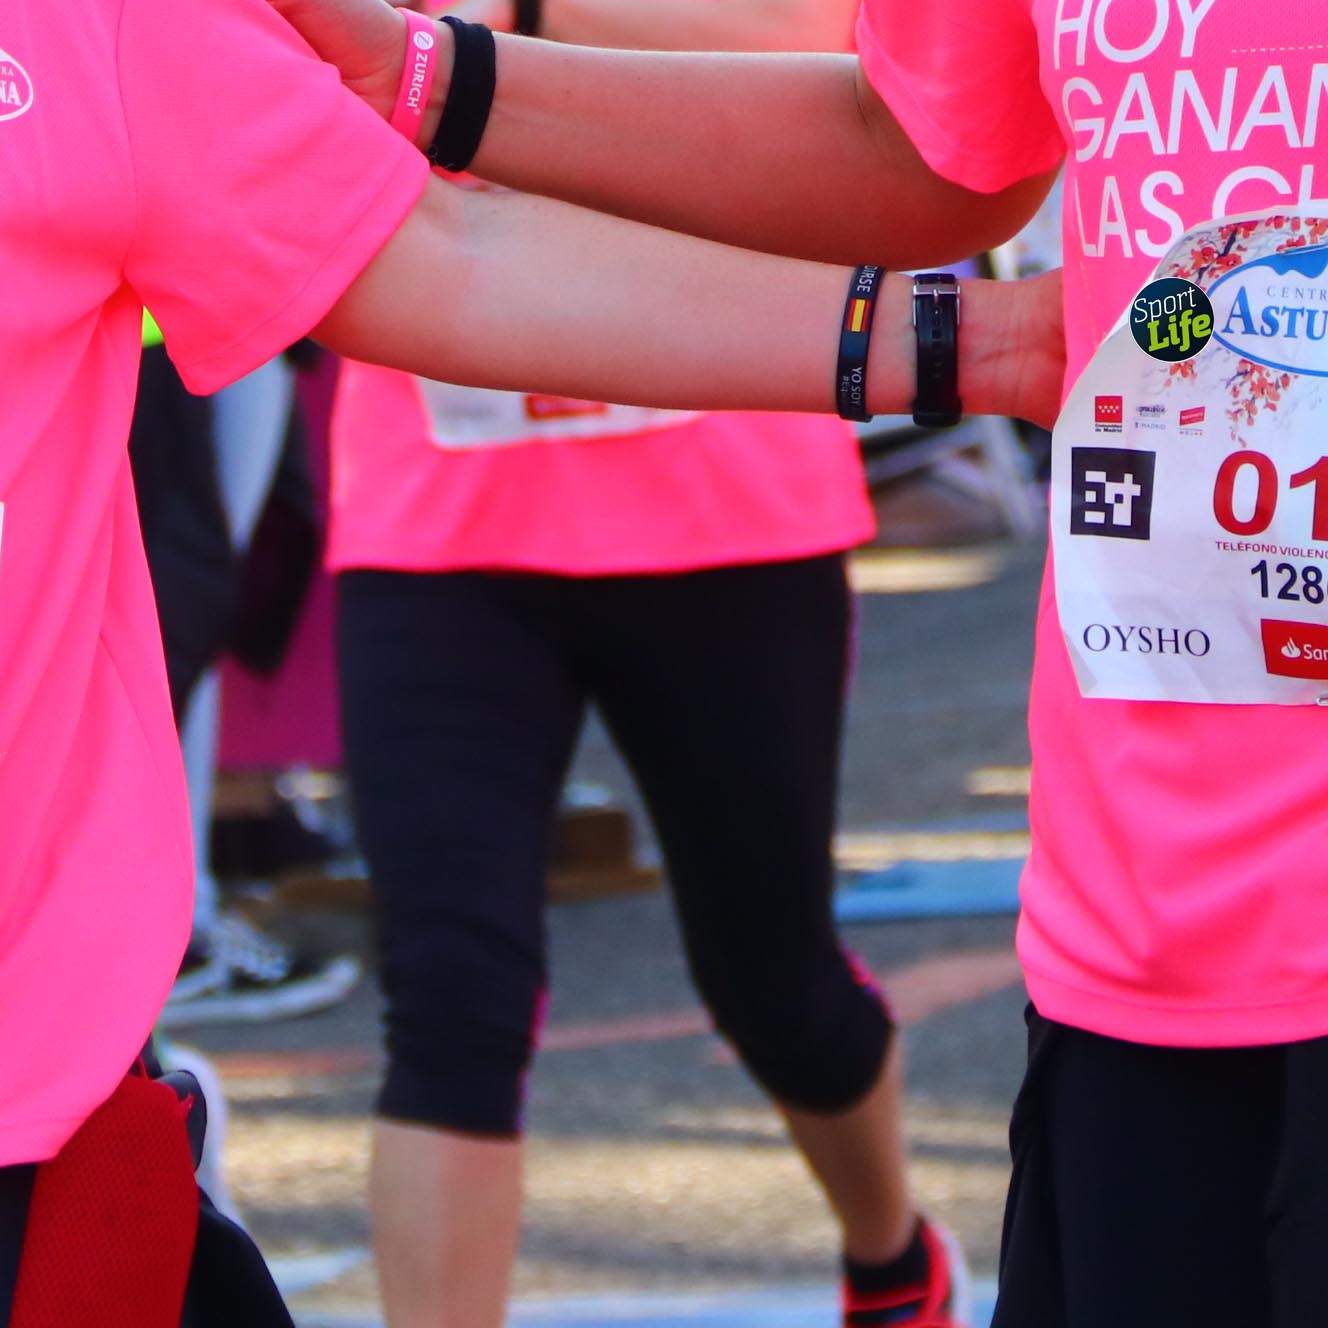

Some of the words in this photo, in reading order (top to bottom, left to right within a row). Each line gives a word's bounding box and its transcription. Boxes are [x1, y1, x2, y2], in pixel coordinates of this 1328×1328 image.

[406, 53, 429, 109] ZURICH
[1072, 169, 1185, 259] LAS
[1133, 286, 1198, 323] Sport
[1147, 309, 1211, 352] Life
[851, 367, 862, 383] YO
[1215, 540, 1278, 555] TELÉFONO
[1082, 623, 1211, 658] OYSHO
